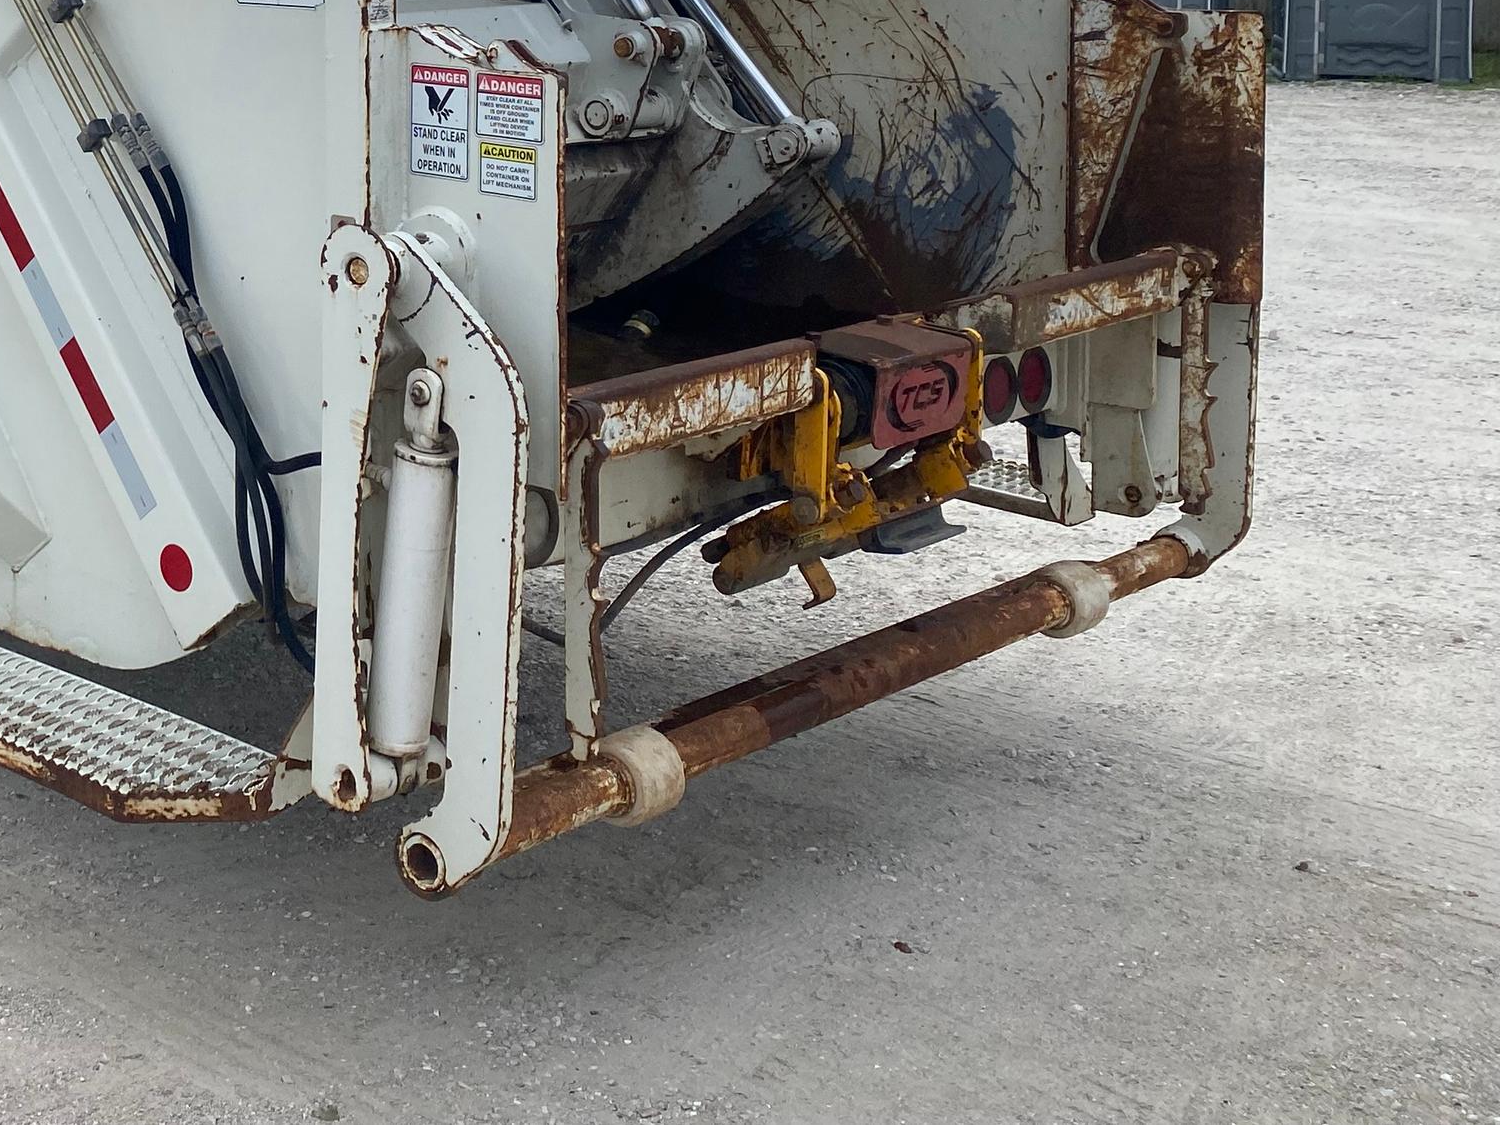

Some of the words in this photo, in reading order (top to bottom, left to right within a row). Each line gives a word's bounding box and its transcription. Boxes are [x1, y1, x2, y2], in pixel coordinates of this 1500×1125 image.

[424, 70, 468, 85] DANGER
[490, 79, 542, 96] DANGER
[511, 105, 540, 113] CONTAINER
[413, 126, 438, 140] STAND
[440, 129, 466, 144] CLEAR
[423, 144, 446, 159] WHEN
[447, 146, 456, 159] IN
[491, 146, 533, 162] CAUTION
[417, 158, 461, 175] OPERATION
[510, 166, 530, 174] CARRY
[486, 171, 520, 182] CONTAINER
[495, 180, 532, 191] MECHANISM
[901, 377, 946, 413] TCS
